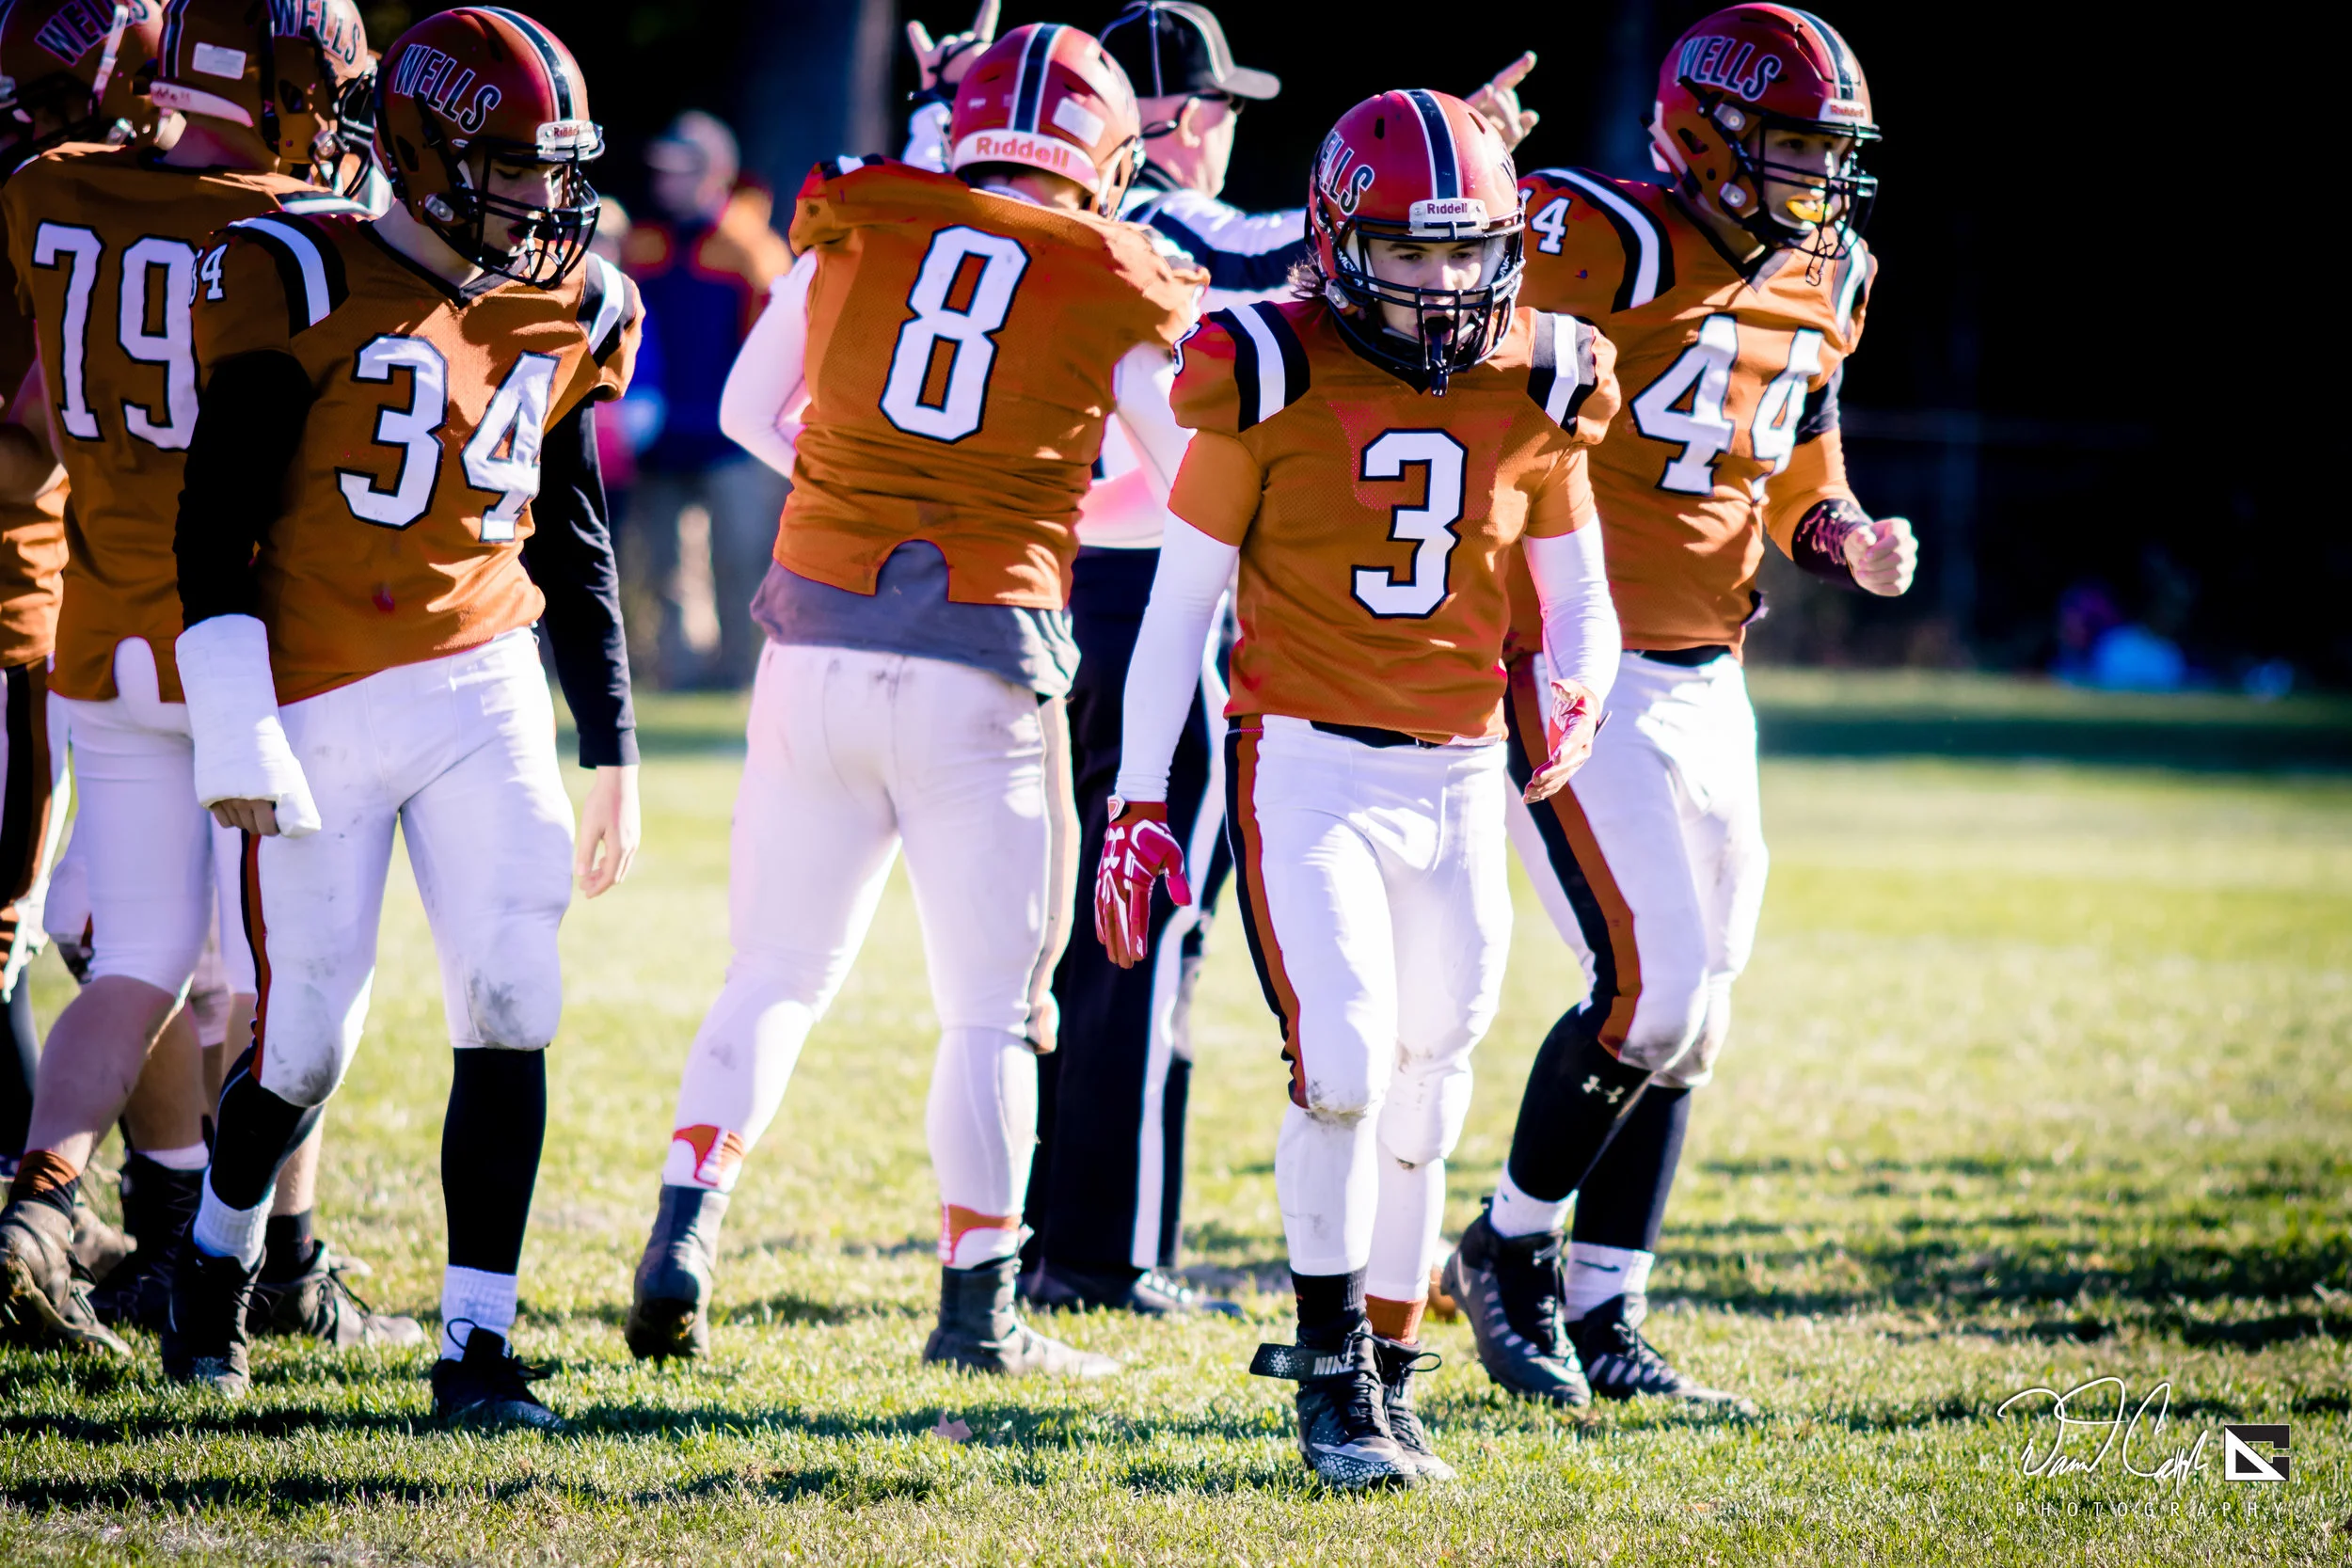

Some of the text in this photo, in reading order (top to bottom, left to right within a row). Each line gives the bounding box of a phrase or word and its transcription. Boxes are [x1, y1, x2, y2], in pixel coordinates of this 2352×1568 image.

[393, 43, 502, 135] WELLS
[1676, 36, 1782, 102] WELLS
[976, 136, 1071, 170] Riddell
[1318, 131, 1375, 215] ELLS
[1426, 202, 1468, 214] Riddell
[32, 220, 199, 451] 79
[879, 224, 1032, 444] 8
[334, 333, 561, 543] 34
[1629, 312, 1824, 504] 44
[1351, 428, 1467, 619] 3
